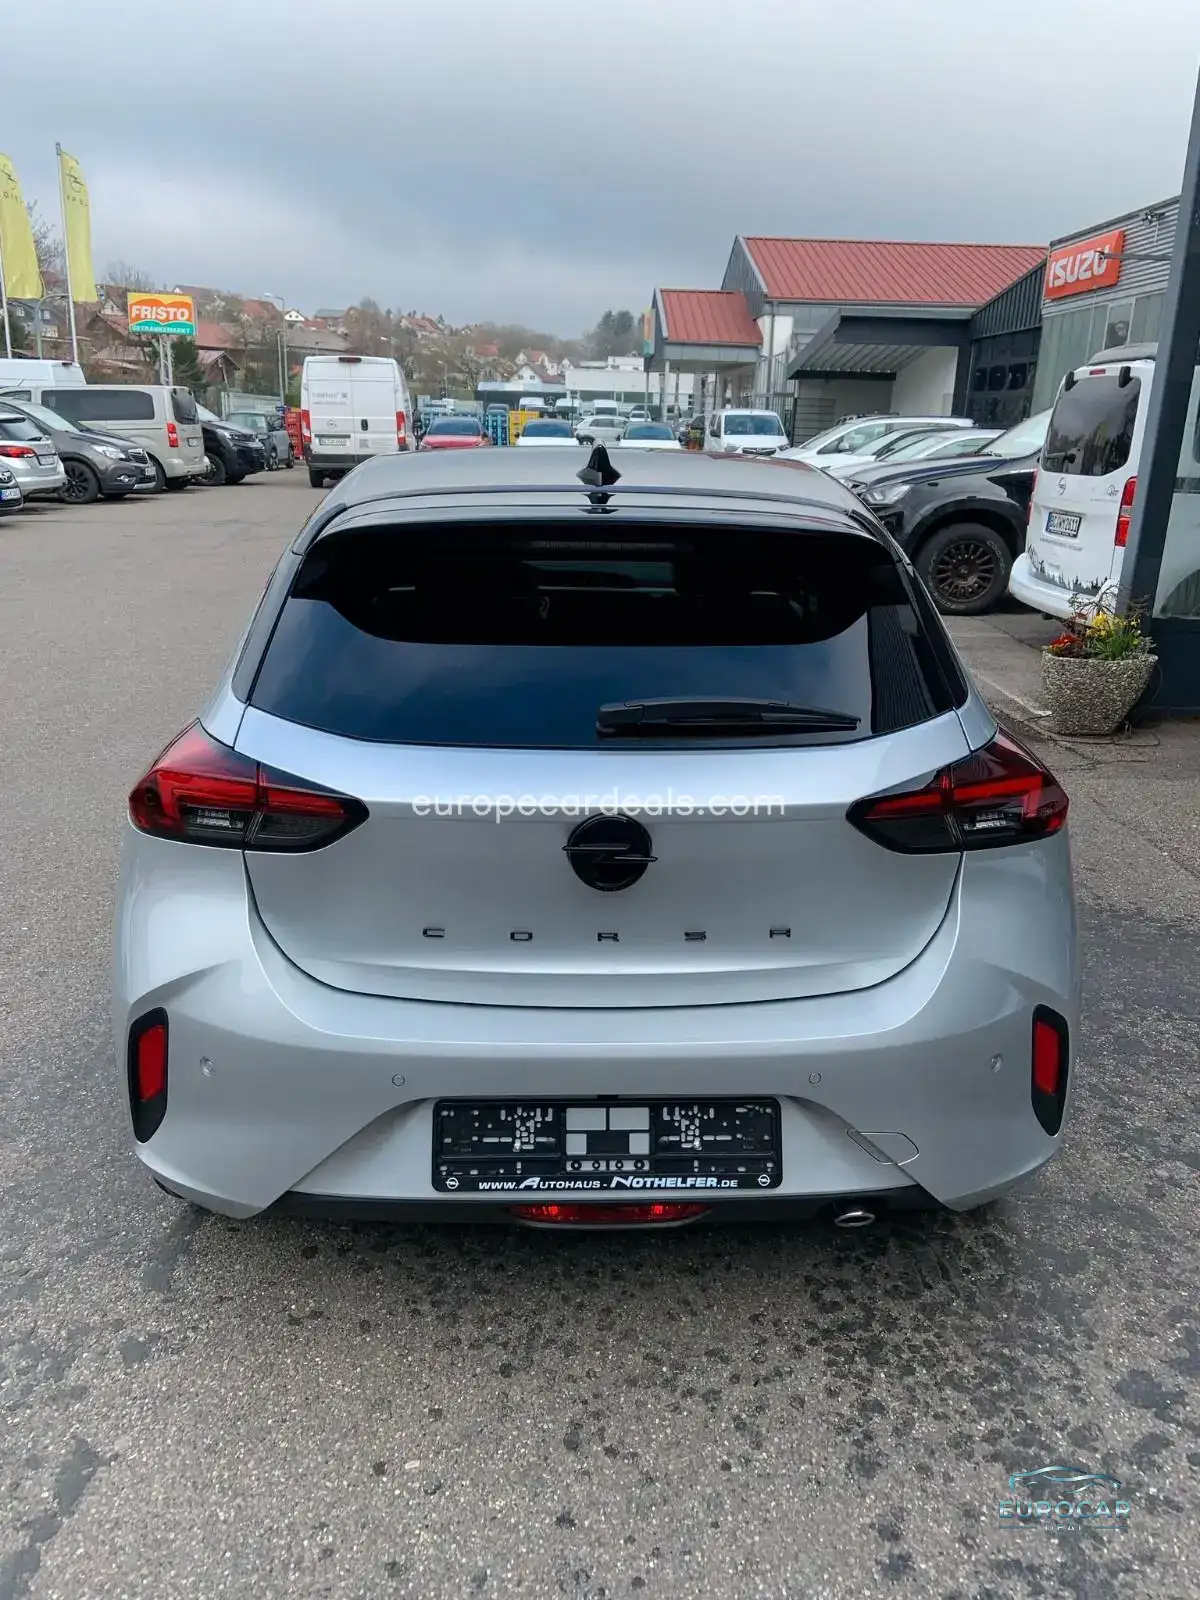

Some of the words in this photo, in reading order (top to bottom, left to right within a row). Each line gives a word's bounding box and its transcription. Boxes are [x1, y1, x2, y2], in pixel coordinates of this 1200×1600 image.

[1048, 244, 1111, 289] ISUZU
[131, 304, 190, 321] FRISTO
[422, 926, 792, 942] CORSA
